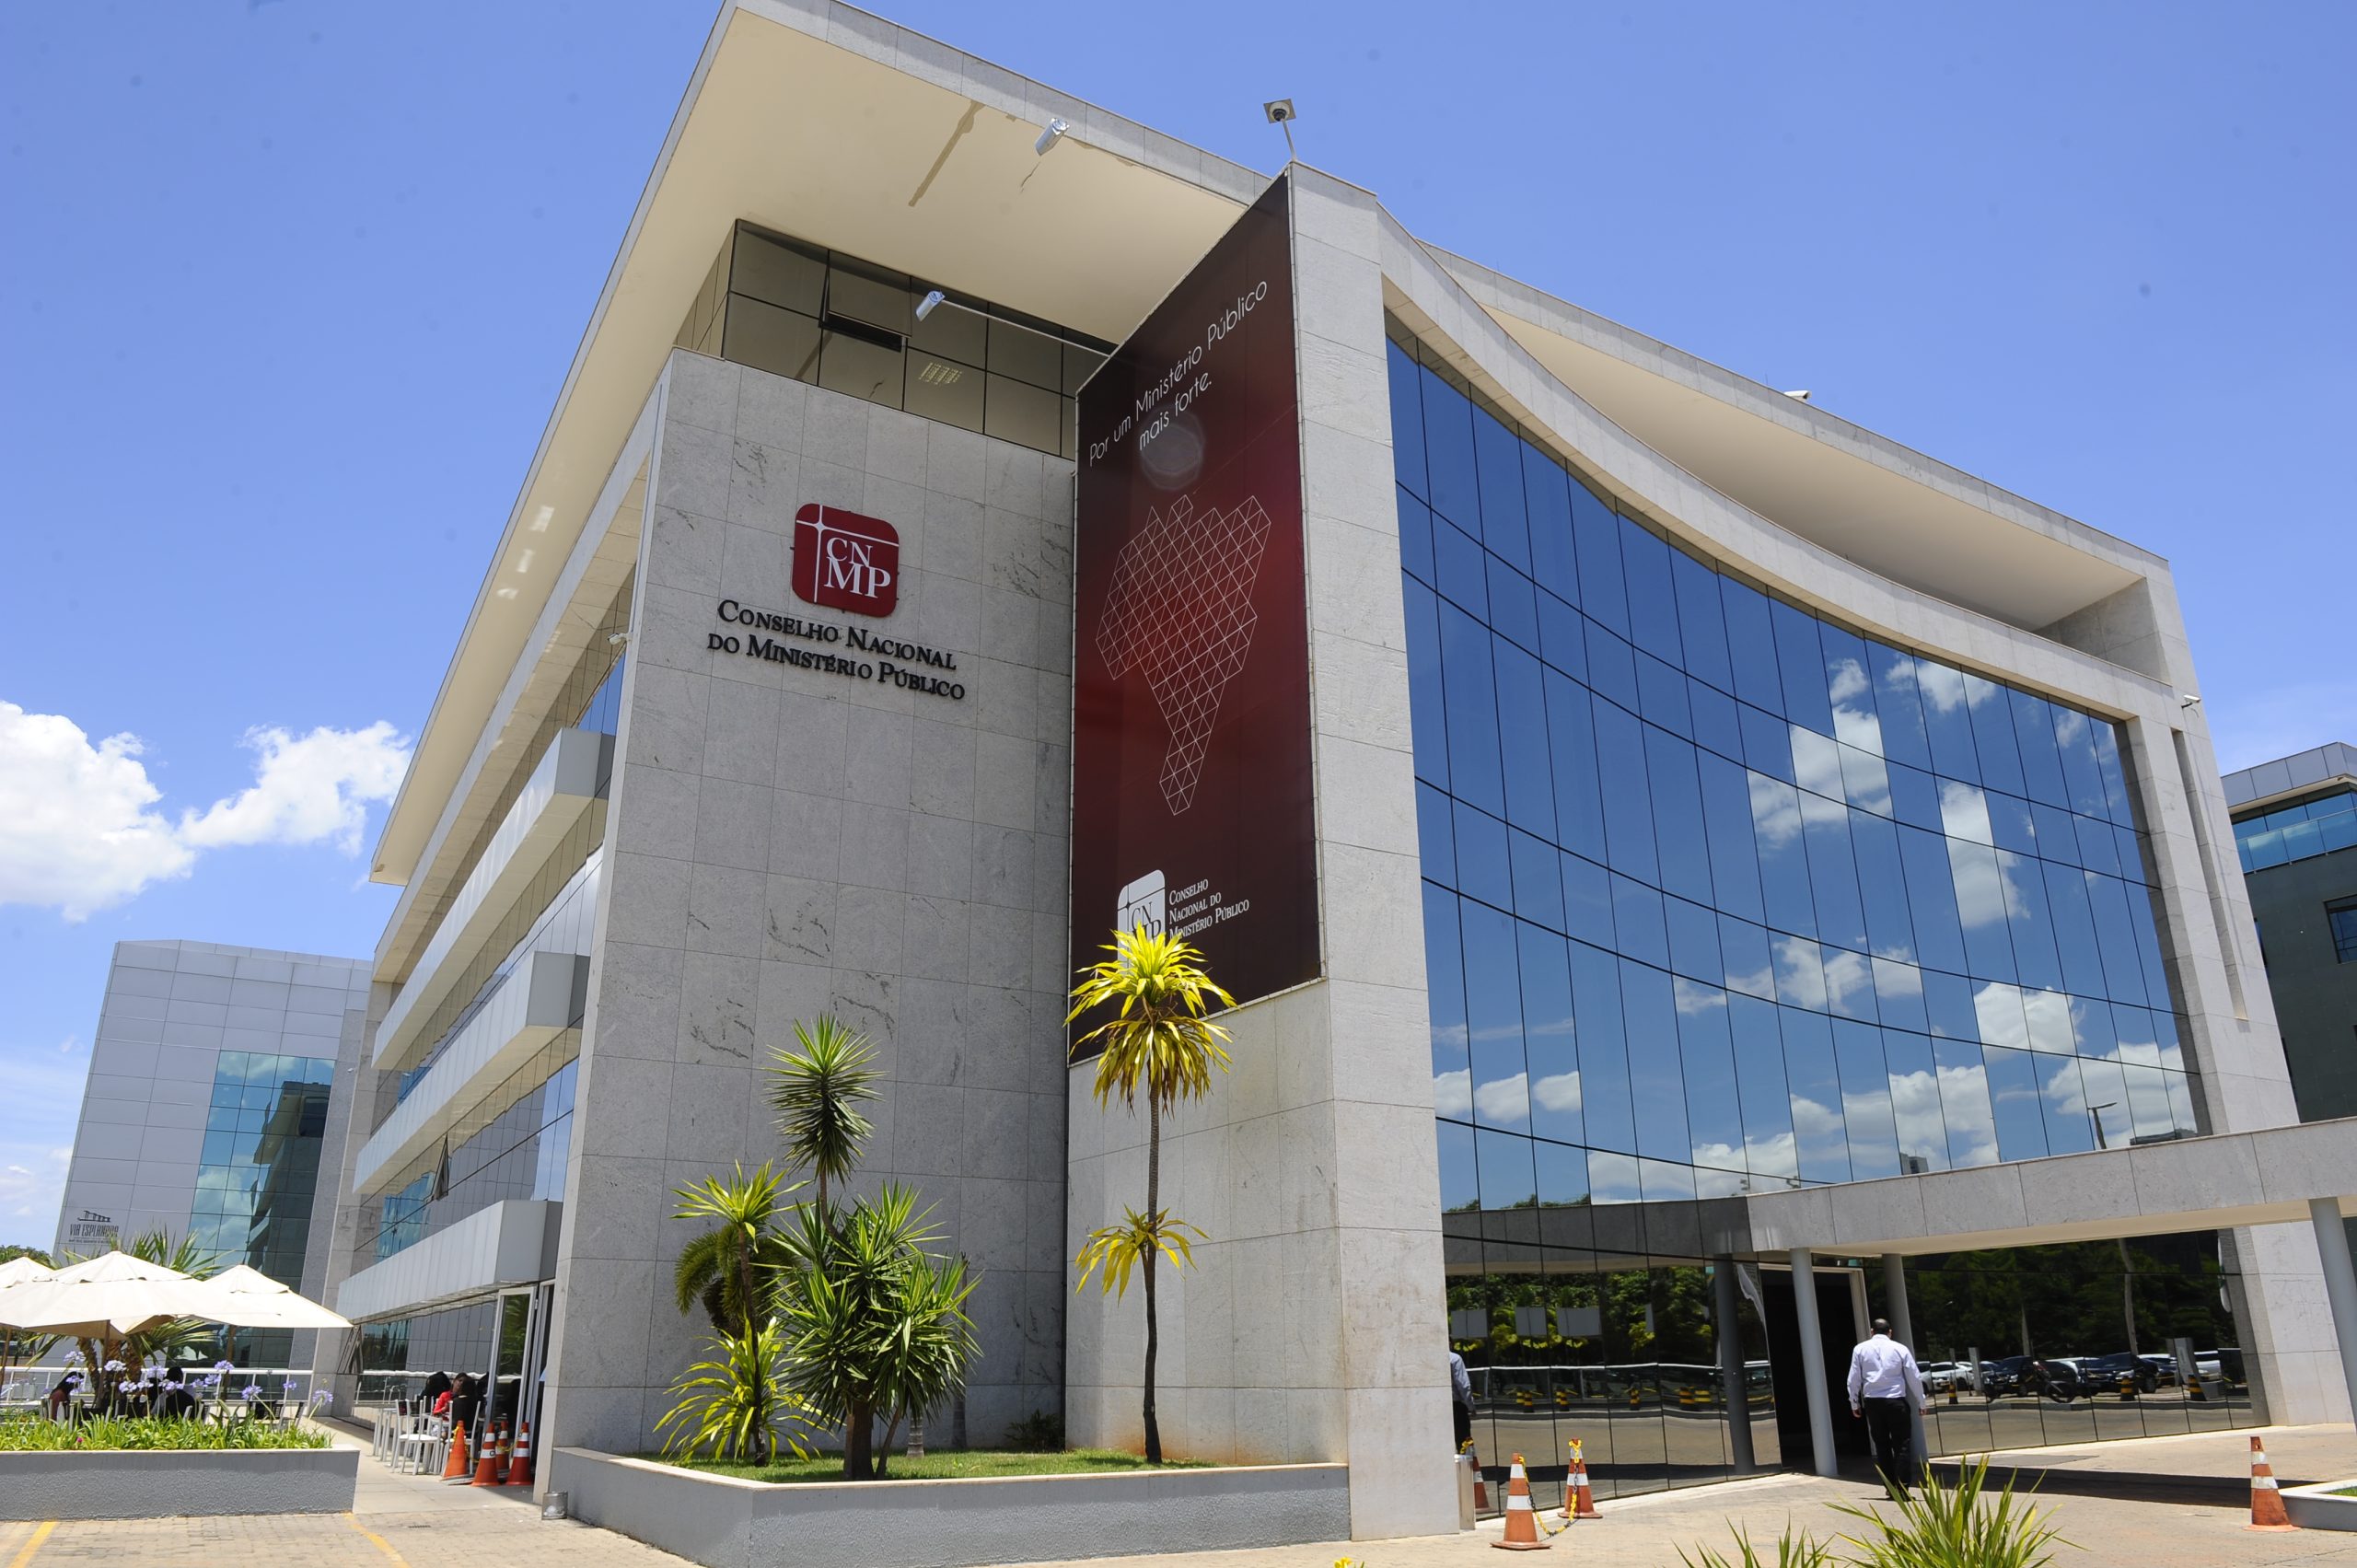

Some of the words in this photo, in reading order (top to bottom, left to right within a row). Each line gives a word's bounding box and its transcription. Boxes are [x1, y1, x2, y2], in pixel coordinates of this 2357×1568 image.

[1089, 436, 1109, 467] Por
[1113, 415, 1131, 442] um
[1136, 346, 1202, 421] Ministério
[1207, 281, 1267, 350] Público
[1139, 411, 1169, 450] mais
[1175, 372, 1212, 416] forte.
